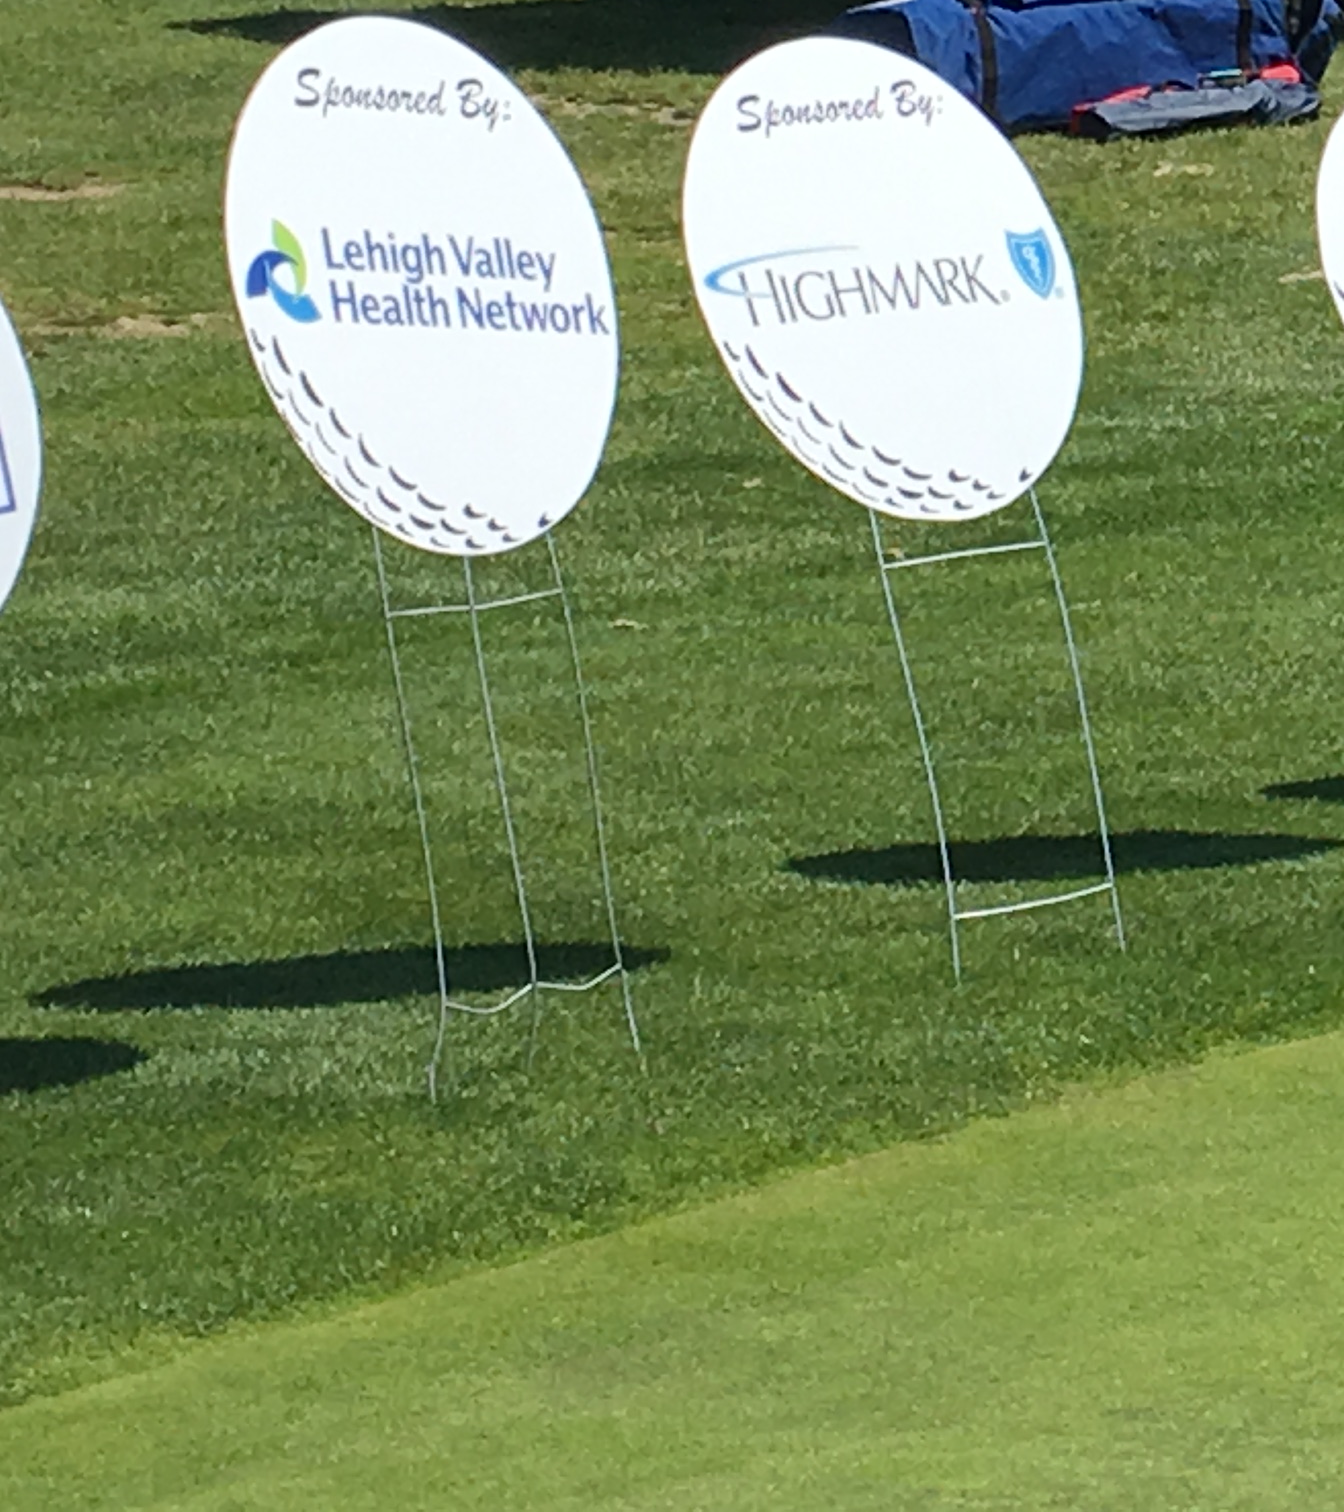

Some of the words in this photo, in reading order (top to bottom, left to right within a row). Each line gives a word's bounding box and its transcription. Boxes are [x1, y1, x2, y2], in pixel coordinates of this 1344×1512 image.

[294, 67, 447, 117] Sponsored
[456, 78, 512, 132] By:
[736, 86, 884, 137] Sponsored
[890, 79, 943, 126] By:
[321, 227, 447, 284] Lehigh
[448, 235, 556, 292] Valley
[738, 254, 1001, 327] HIGHMARK
[329, 280, 452, 329] Health
[457, 287, 610, 336] Network
